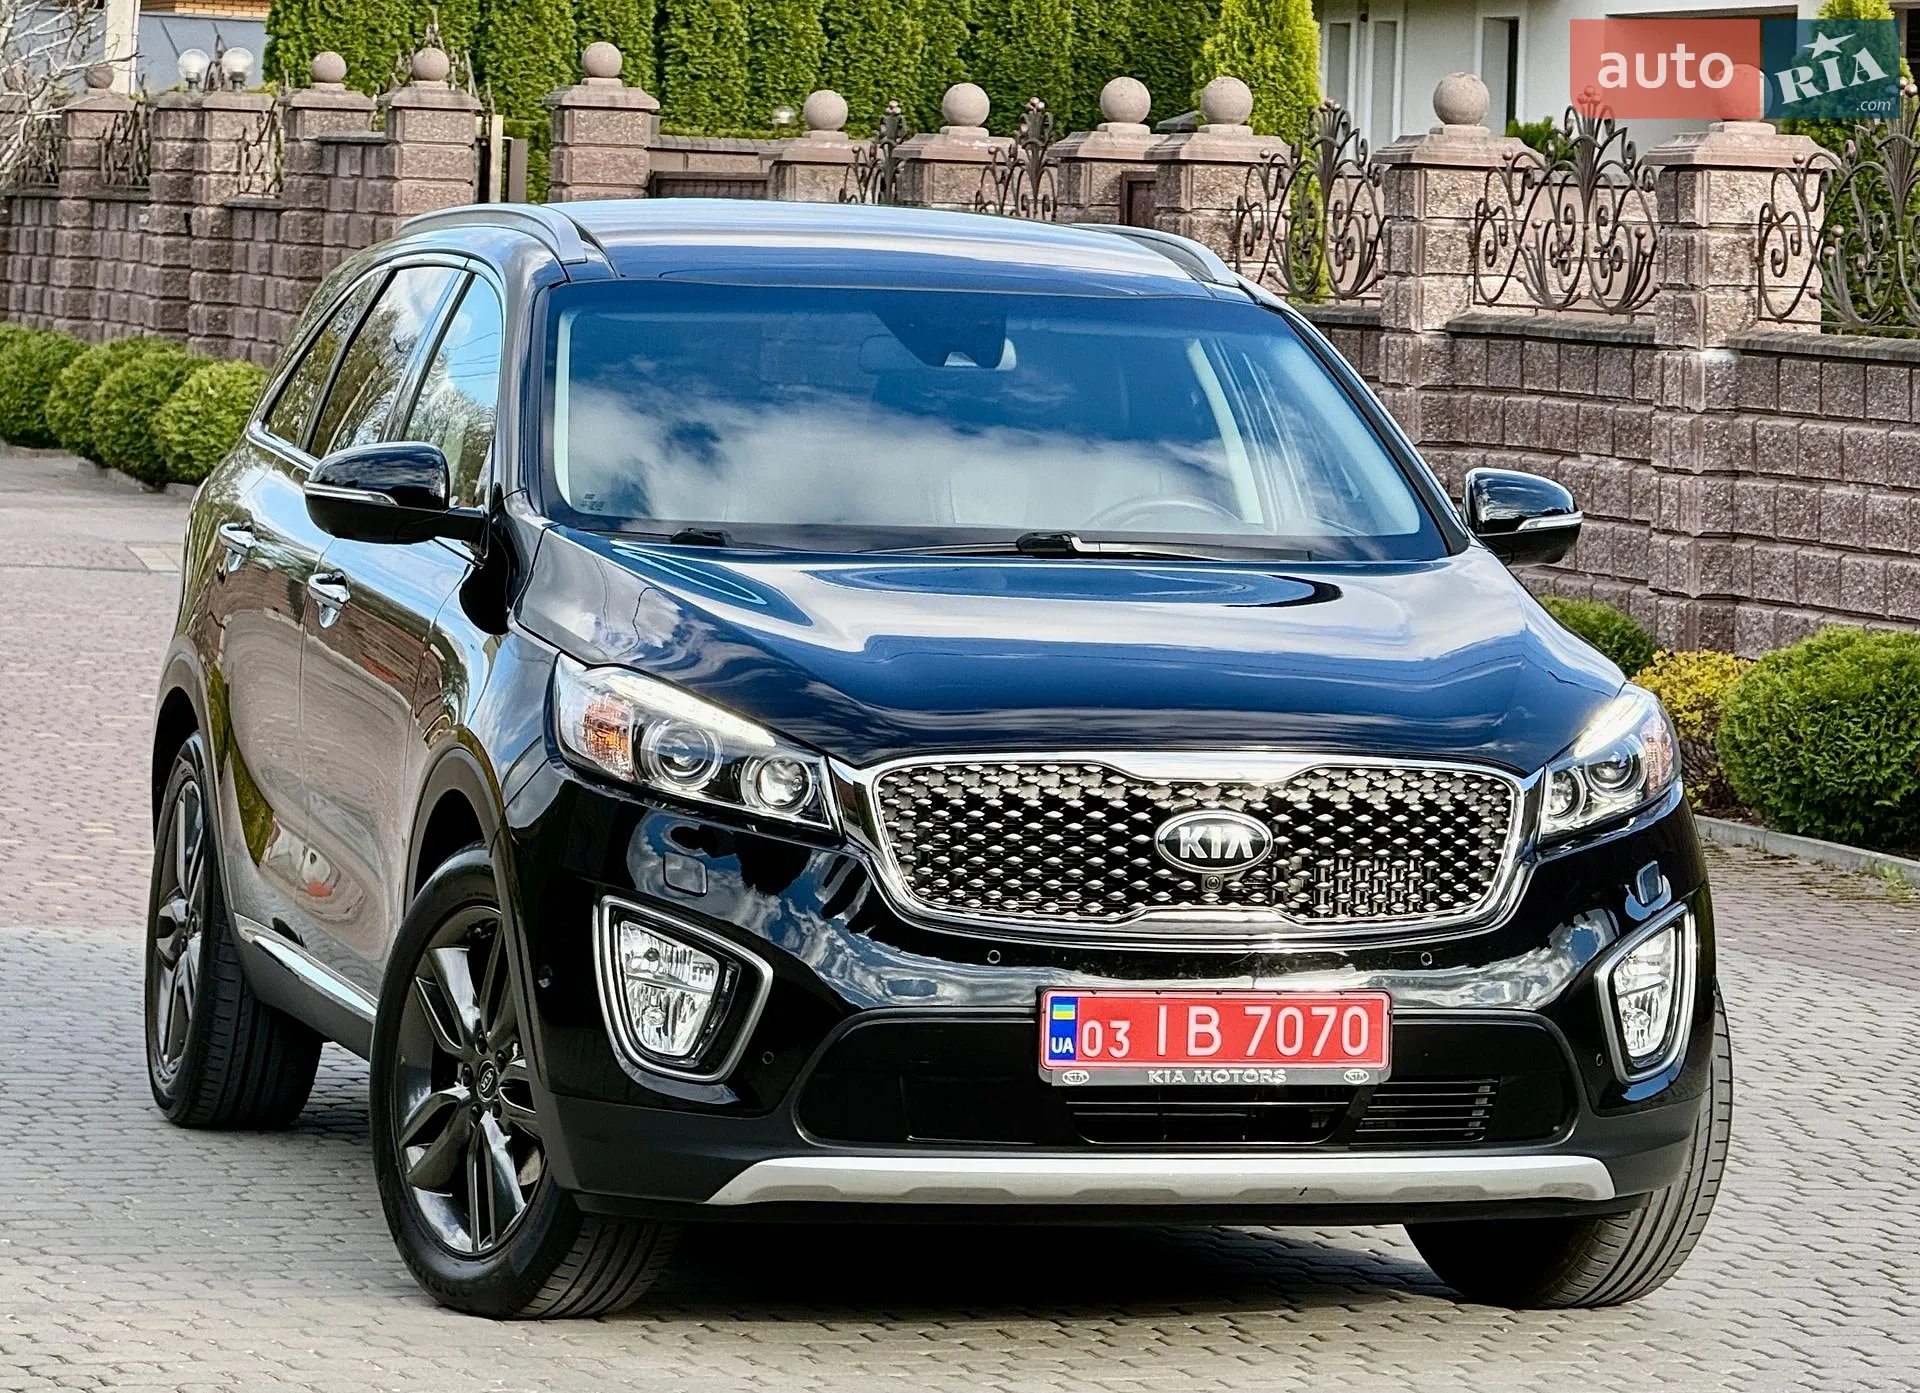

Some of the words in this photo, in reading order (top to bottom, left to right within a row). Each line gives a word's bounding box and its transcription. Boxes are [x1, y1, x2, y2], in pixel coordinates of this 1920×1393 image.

[1178, 826, 1254, 859] KIA
[1081, 1020, 1131, 1058] 03
[1157, 1004, 1223, 1057] IB
[1244, 1005, 1370, 1057] 7070
[1051, 1036, 1075, 1054] UA
[1147, 1070, 1186, 1083] KIA
[1194, 1069, 1287, 1084] MOTORS
